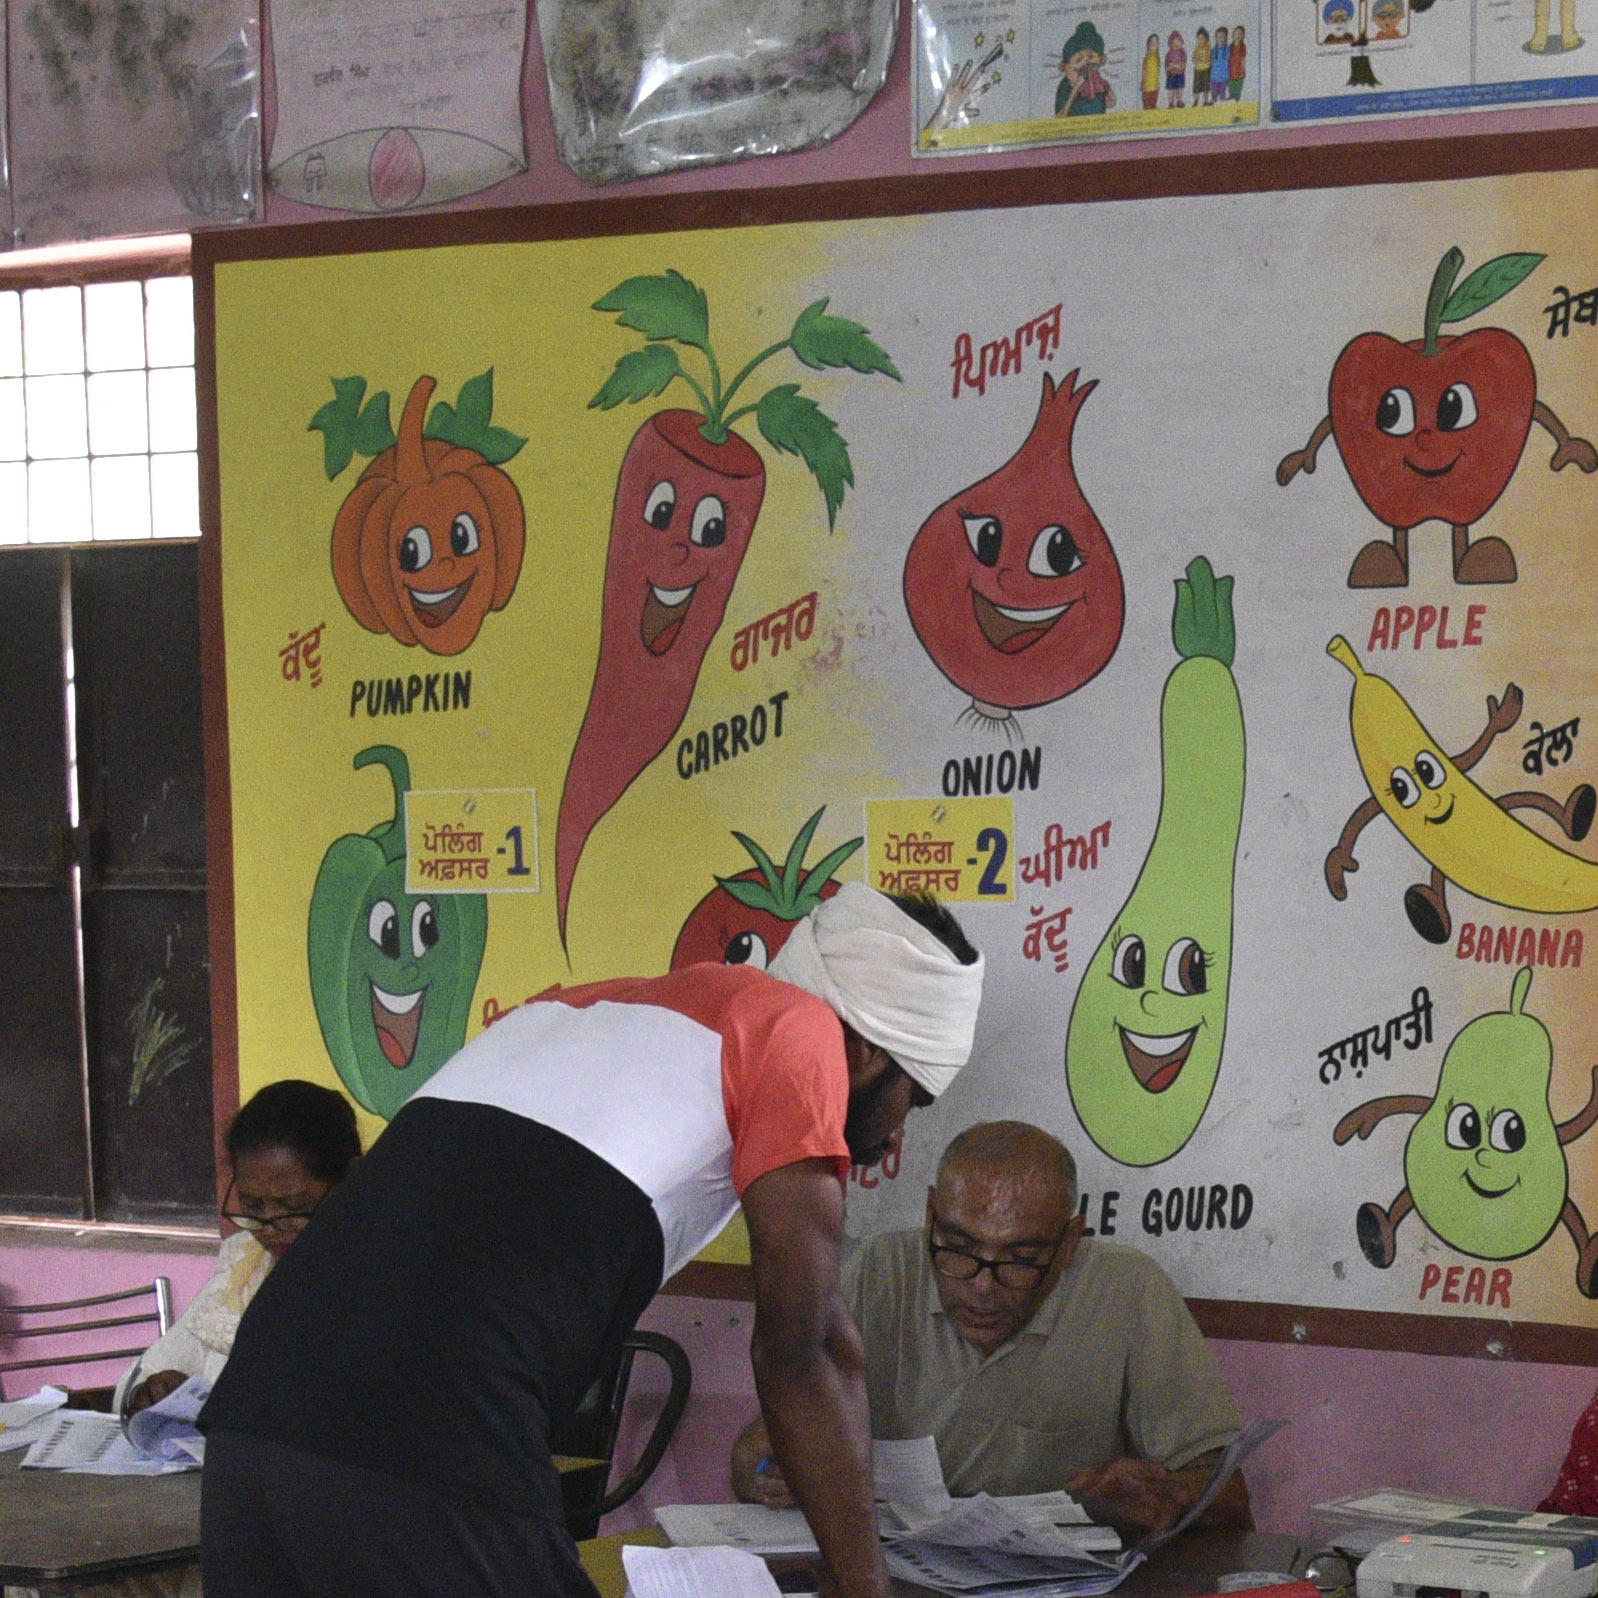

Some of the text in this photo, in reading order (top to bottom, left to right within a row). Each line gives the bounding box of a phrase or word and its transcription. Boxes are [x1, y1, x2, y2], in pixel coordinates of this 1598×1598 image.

[950, 303, 1063, 399] ਪਿਆਜ਼
[279, 622, 326, 688] ਕੱਦੂ
[730, 591, 819, 672] ਗਾਜਰ
[1367, 604, 1487, 652] APPLE
[350, 670, 472, 719] PUMPKIN
[676, 691, 789, 780] CARROT
[1521, 716, 1581, 776] ਕੇਲਾ
[942, 746, 1042, 798] ONION
[422, 822, 485, 854] ਪੋਲਿੰਗ
[884, 831, 955, 865] ਪੋਲਿੰਗ
[1018, 819, 1113, 887] ਘੀਆ
[1022, 903, 1073, 974] ਕੱਦੂ
[1456, 922, 1584, 968] BANANA
[1318, 986, 1435, 1085] ਨਾਸ਼ਪਾਤੀ
[1142, 1183, 1254, 1237] GOURD
[1418, 1263, 1514, 1309] PEAR
